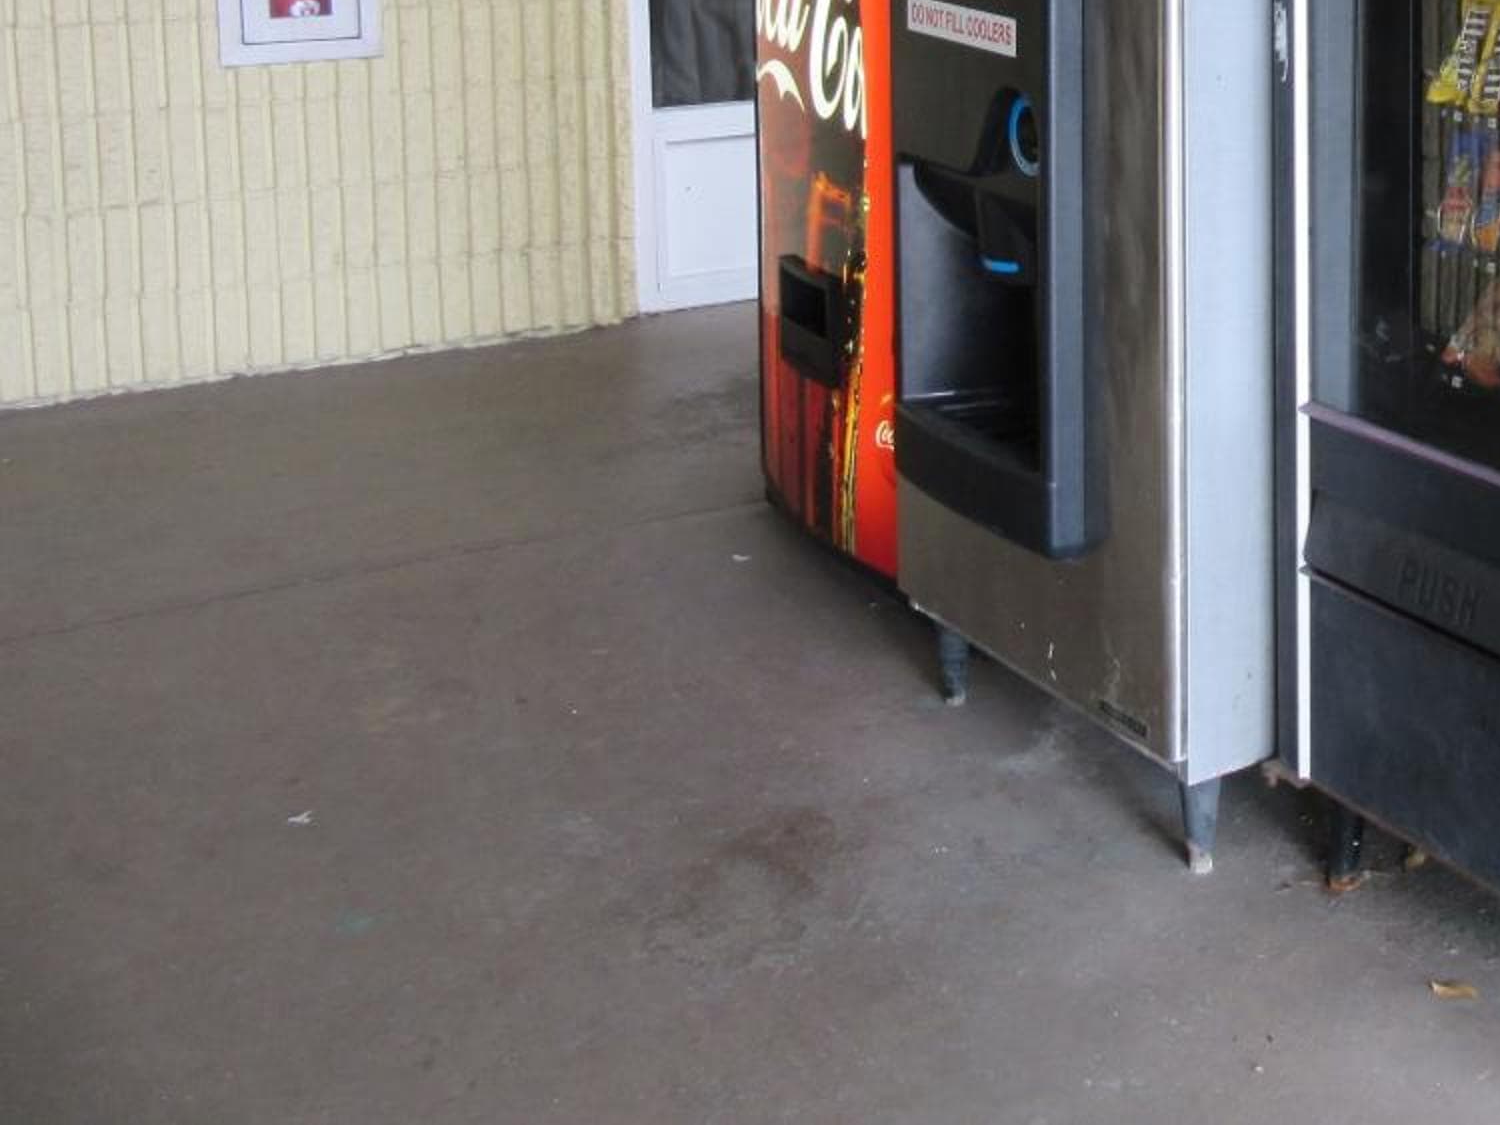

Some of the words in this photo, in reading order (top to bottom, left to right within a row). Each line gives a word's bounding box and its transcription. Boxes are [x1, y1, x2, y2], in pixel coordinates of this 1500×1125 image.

[911, 2, 925, 25] DO
[925, 5, 944, 28] NOT
[945, 10, 964, 34] FILL
[965, 16, 1012, 46] COOLERS
[1396, 555, 1481, 628] PUSH
